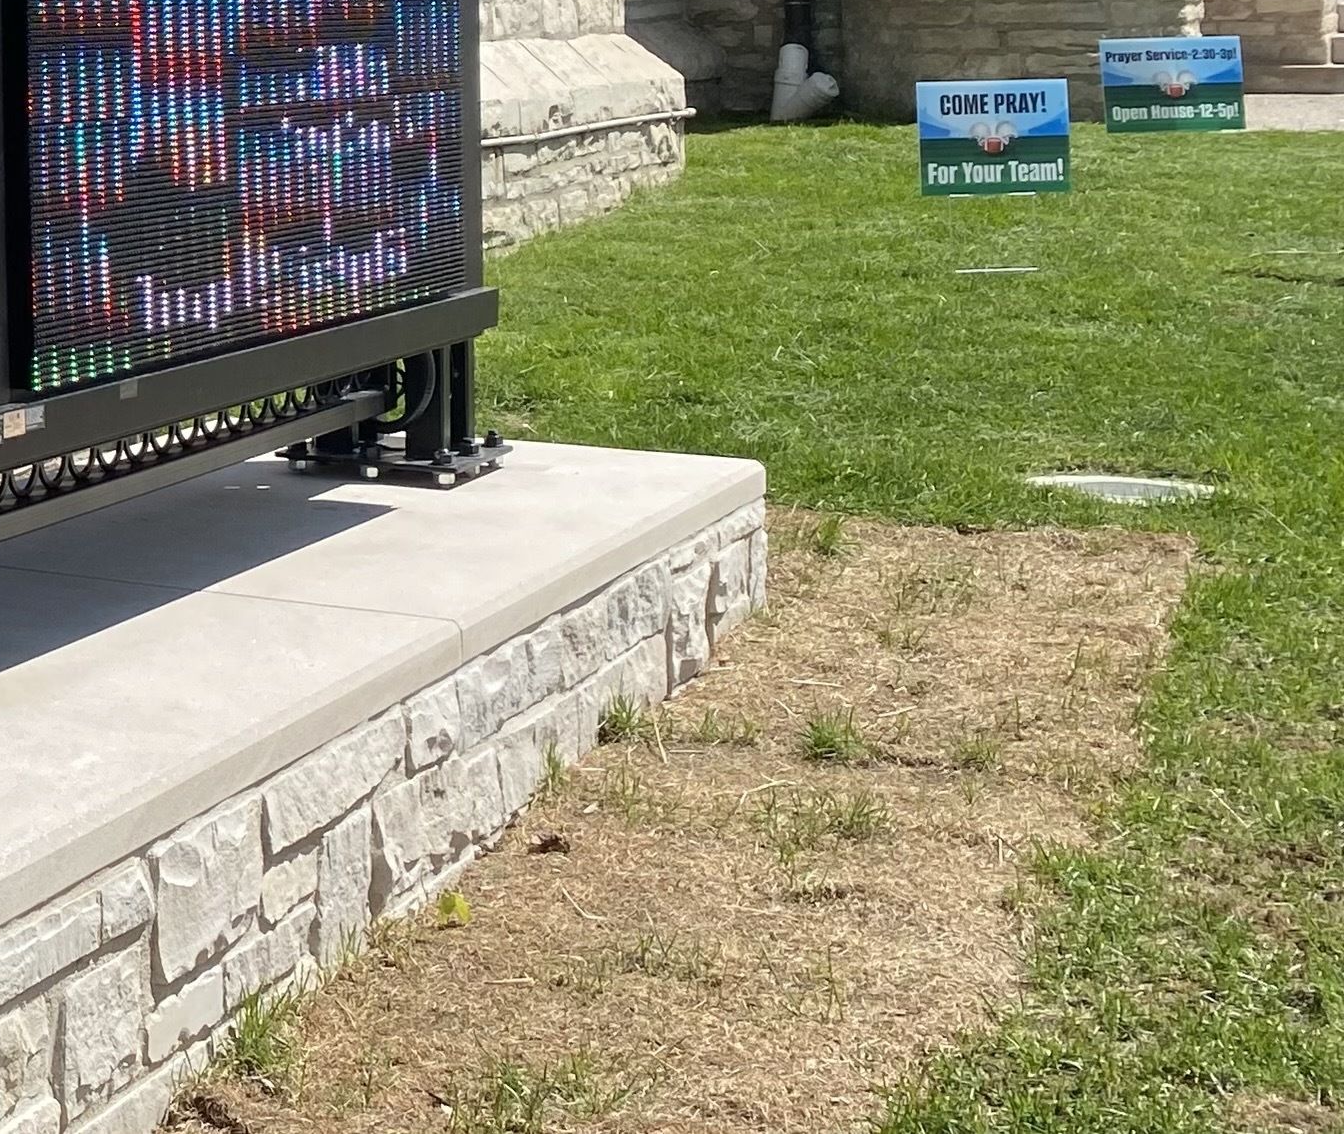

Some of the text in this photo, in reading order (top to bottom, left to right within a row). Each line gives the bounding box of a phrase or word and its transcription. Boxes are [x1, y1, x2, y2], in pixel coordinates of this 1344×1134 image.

[1105, 51, 1144, 64] Prayer
[940, 91, 1047, 116] COME PRAY!
[1112, 102, 1239, 122] Open House-12-5p!
[927, 158, 1065, 185] For Your Team!
